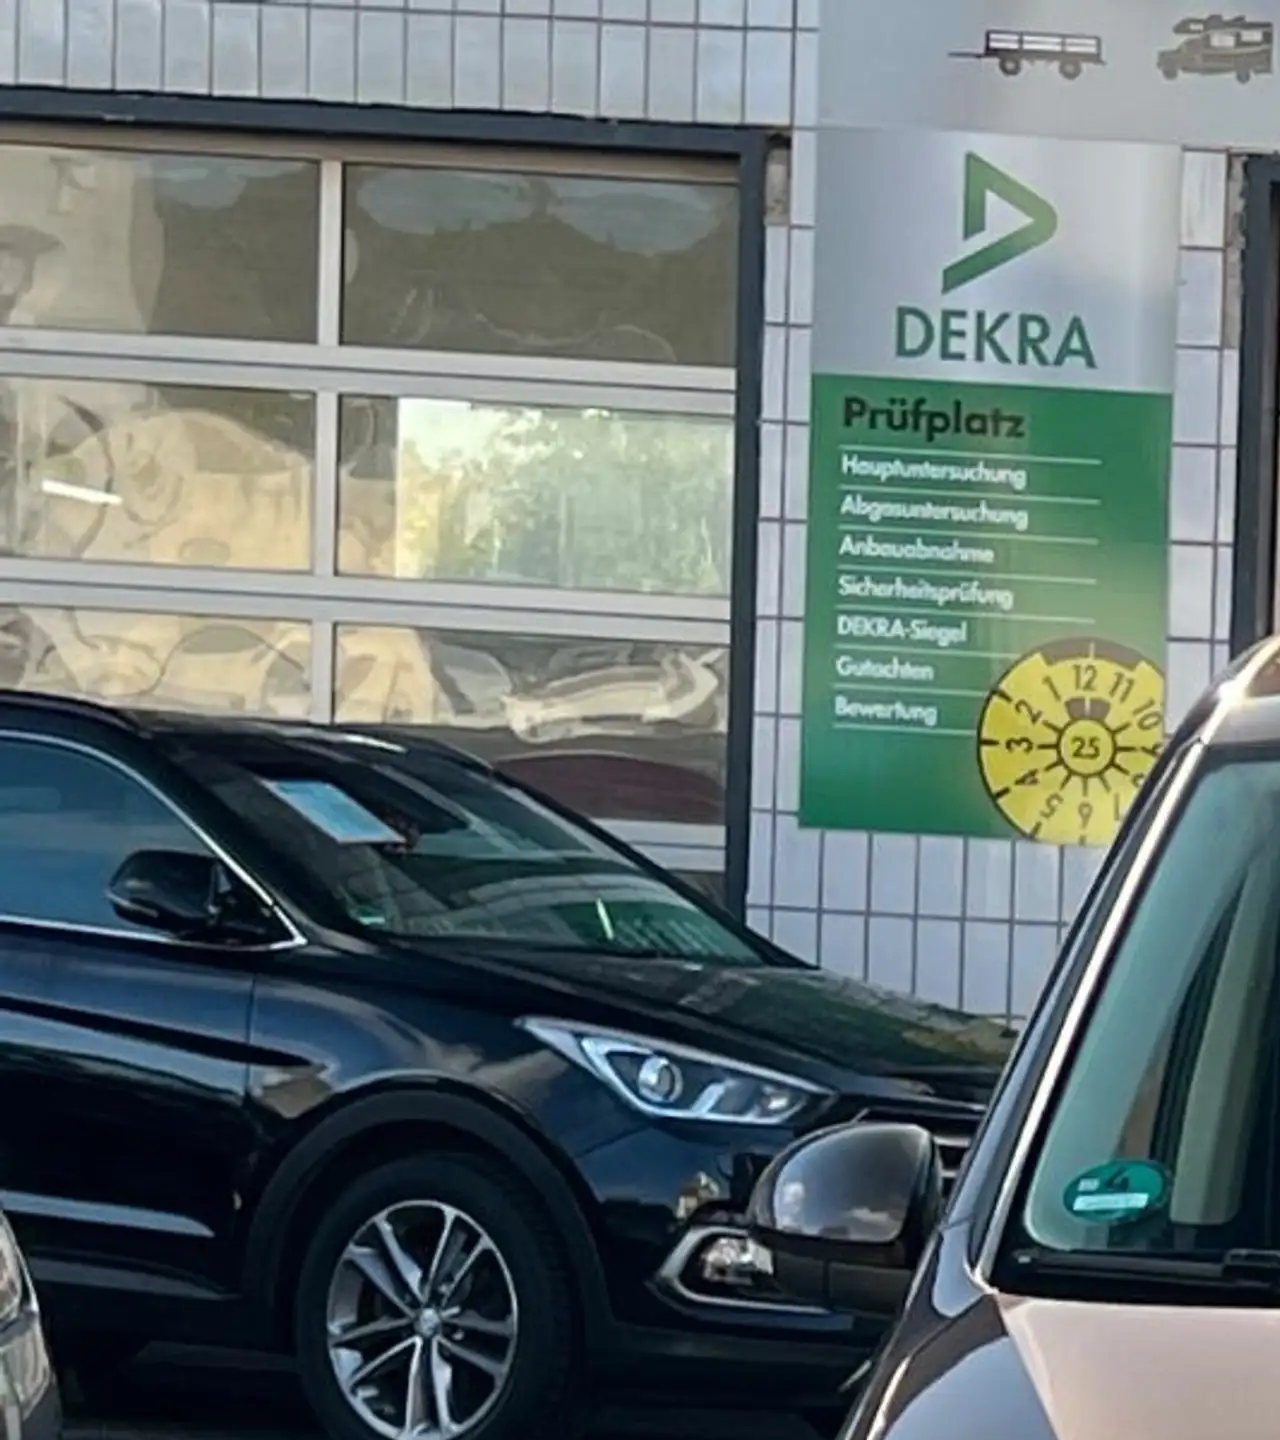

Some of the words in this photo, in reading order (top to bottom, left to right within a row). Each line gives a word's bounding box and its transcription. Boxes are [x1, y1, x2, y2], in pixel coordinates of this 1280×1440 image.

[895, 306, 1098, 369] DEKRA
[843, 395, 1026, 442] Prüfplatz
[841, 453, 1027, 490] Hauptuntersuchung
[840, 493, 1029, 531] Abgasuntersuchung
[838, 534, 995, 563] Anbauabnahme
[838, 575, 1014, 610] Sicherheitsprüfung
[837, 614, 967, 647] DEKRA-Siegel
[836, 655, 934, 681] Gutachten
[1072, 664, 1097, 691] 12
[1042, 675, 1061, 703] 1
[1109, 671, 1135, 703] 11
[835, 696, 938, 726] Bewertung
[1015, 699, 1043, 725] 2
[1132, 699, 1163, 731] 10
[1005, 736, 1034, 755] 3
[1071, 736, 1100, 759] 25
[1014, 768, 1040, 785] 4
[1040, 793, 1064, 819] 5
